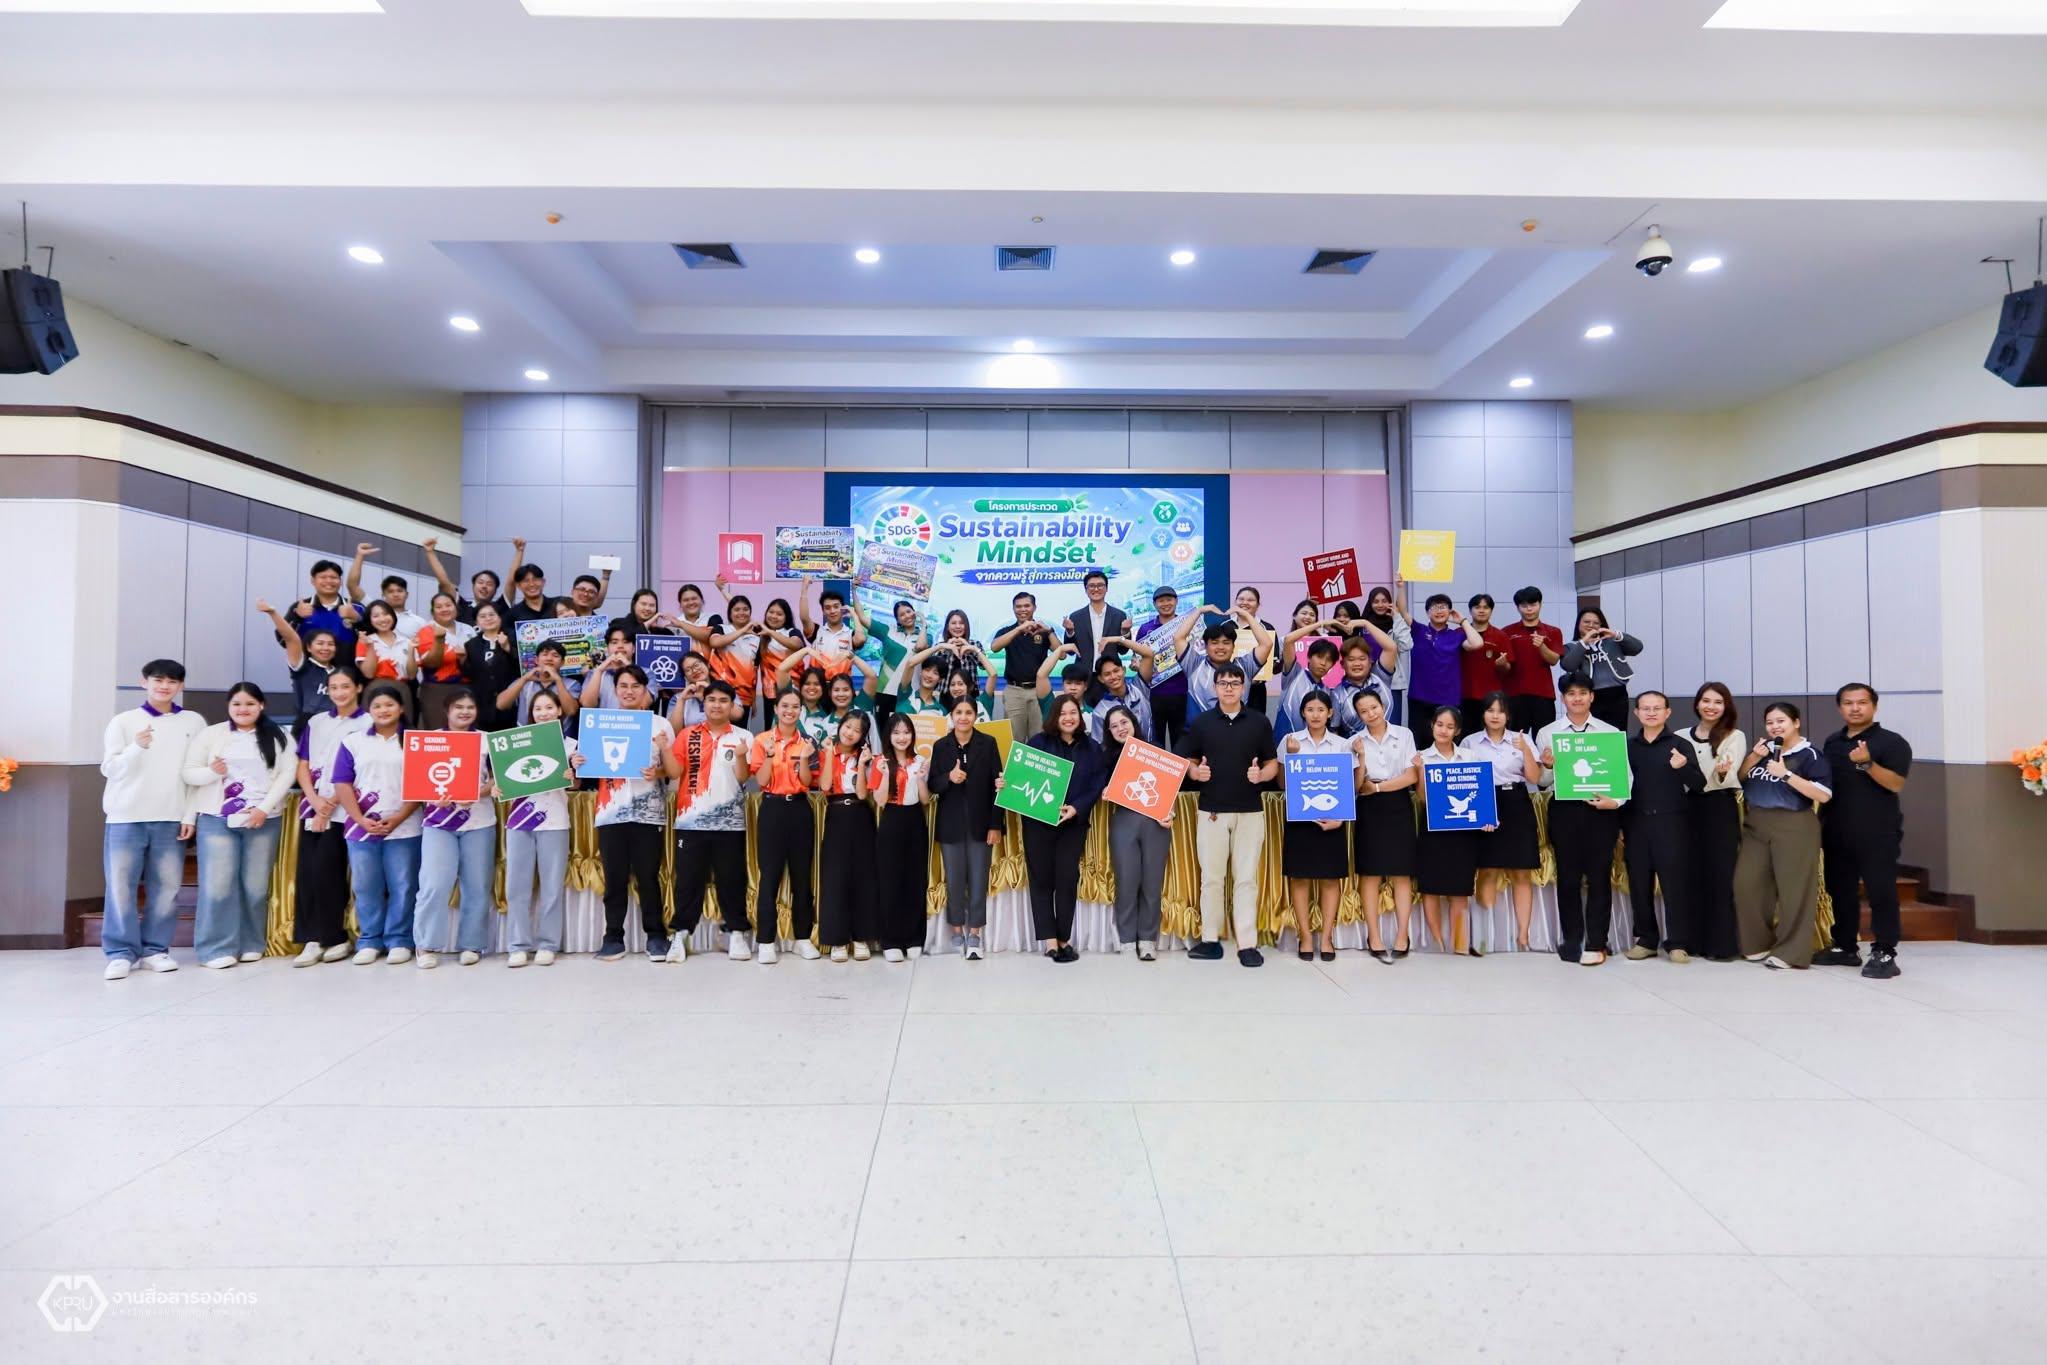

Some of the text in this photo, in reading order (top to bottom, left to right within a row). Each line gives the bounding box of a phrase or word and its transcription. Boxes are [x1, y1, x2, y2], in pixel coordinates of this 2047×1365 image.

[988, 500, 1058, 511] โครงการประกวด
[887, 525, 917, 536] SDGs
[939, 515, 1131, 543] Sustainability
[977, 540, 1096, 563] Mindset
[1307, 560, 1314, 571] 8
[640, 639, 650, 650] 17
[1294, 641, 1304, 652] 10
[585, 714, 594, 728] 6
[410, 736, 420, 751] 5
[491, 736, 508, 752] 13
[1128, 744, 1137, 757] 9
[1555, 738, 1570, 752] 15
[1013, 749, 1023, 762] 3
[1289, 759, 1302, 773] 14
[1428, 769, 1442, 783] 16
